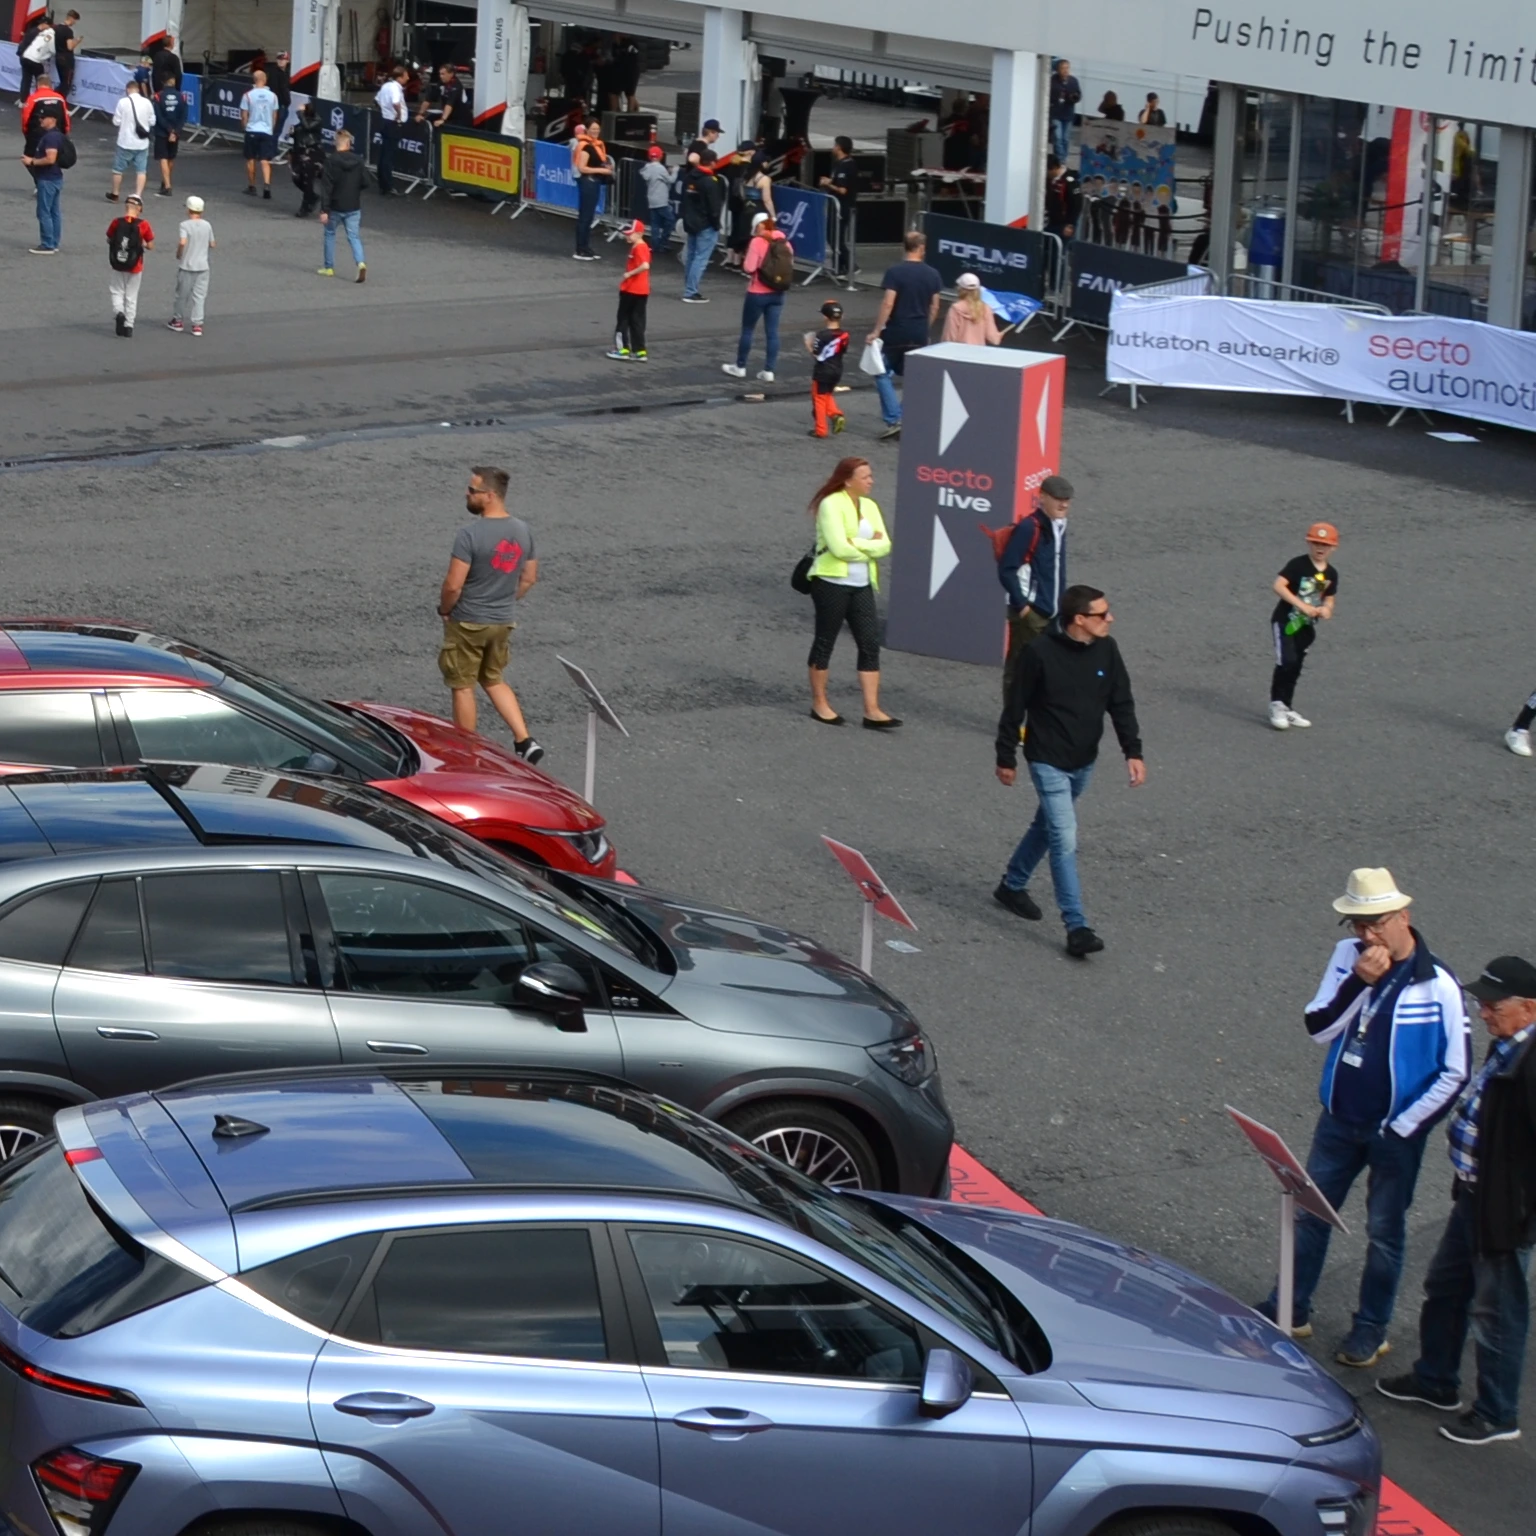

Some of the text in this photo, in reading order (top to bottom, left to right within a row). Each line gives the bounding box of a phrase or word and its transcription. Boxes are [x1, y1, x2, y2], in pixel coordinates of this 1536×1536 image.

[495, 18, 504, 48] EVANS
[1192, 8, 1335, 67] Pushing
[1362, 29, 1421, 70] the
[448, 144, 511, 183] PIRELLI
[938, 239, 1028, 269] FORUM8
[1110, 329, 1209, 353] utkaton
[1368, 333, 1470, 367] secto
[916, 465, 993, 491] secto
[938, 486, 992, 512] live
